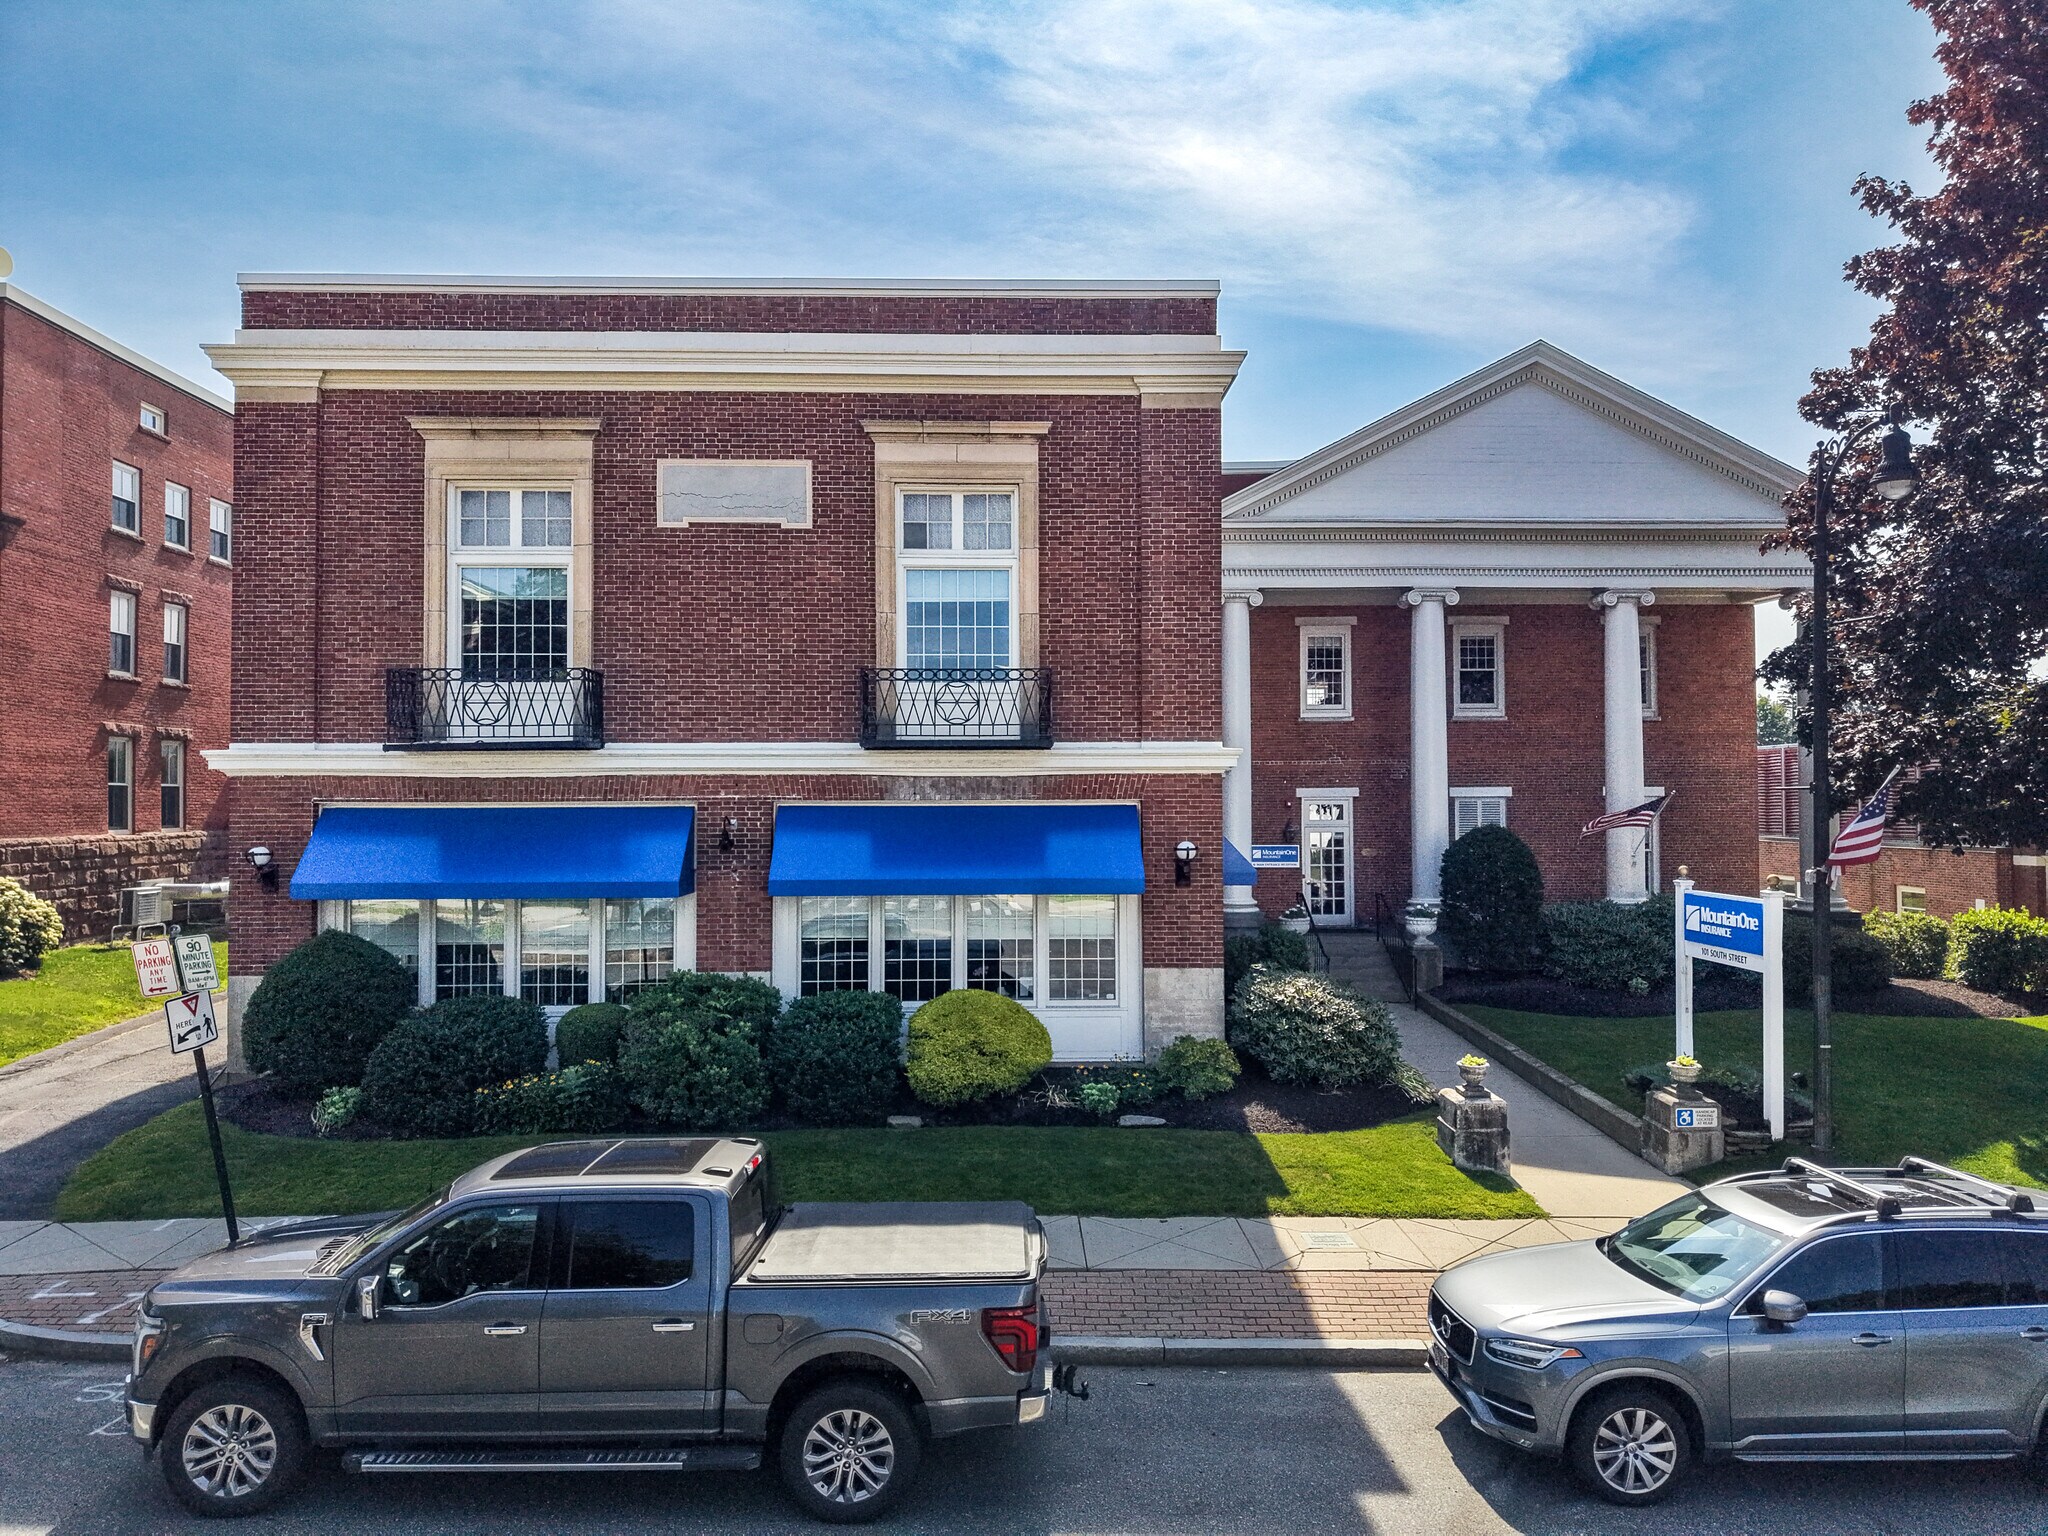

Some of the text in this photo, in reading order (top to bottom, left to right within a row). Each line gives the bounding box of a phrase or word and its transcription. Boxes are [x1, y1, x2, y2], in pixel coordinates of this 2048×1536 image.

[1700, 906, 1759, 931] MountainOne
[1701, 923, 1732, 938] INSURANCE
[144, 945, 159, 956] NO
[186, 941, 202, 953] 90
[182, 951, 210, 961] MINUTE
[1701, 947, 1748, 965] 101 SOUTH STREET
[137, 955, 172, 970] PARKING
[184, 960, 212, 971] PARKING
[149, 968, 164, 977] ANY
[150, 976, 168, 985] TIME
[175, 1019, 192, 1030] HERE
[910, 1308, 971, 1326] FX4
